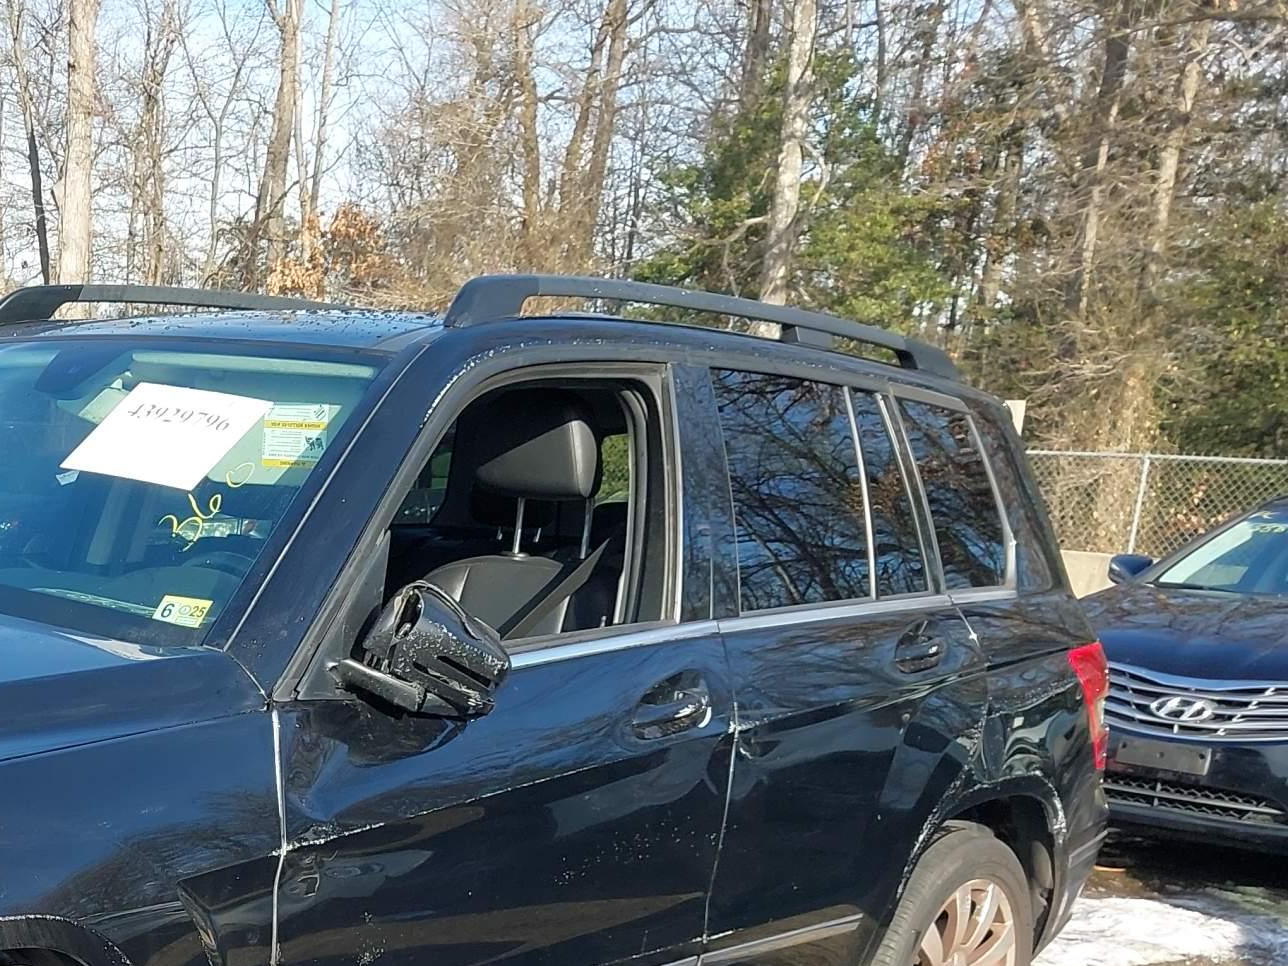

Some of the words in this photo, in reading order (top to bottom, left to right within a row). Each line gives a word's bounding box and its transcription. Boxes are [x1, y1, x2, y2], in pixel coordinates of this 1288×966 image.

[127, 403, 231, 431] 43929796
[160, 602, 176, 618] 6
[188, 605, 207, 618] 25
